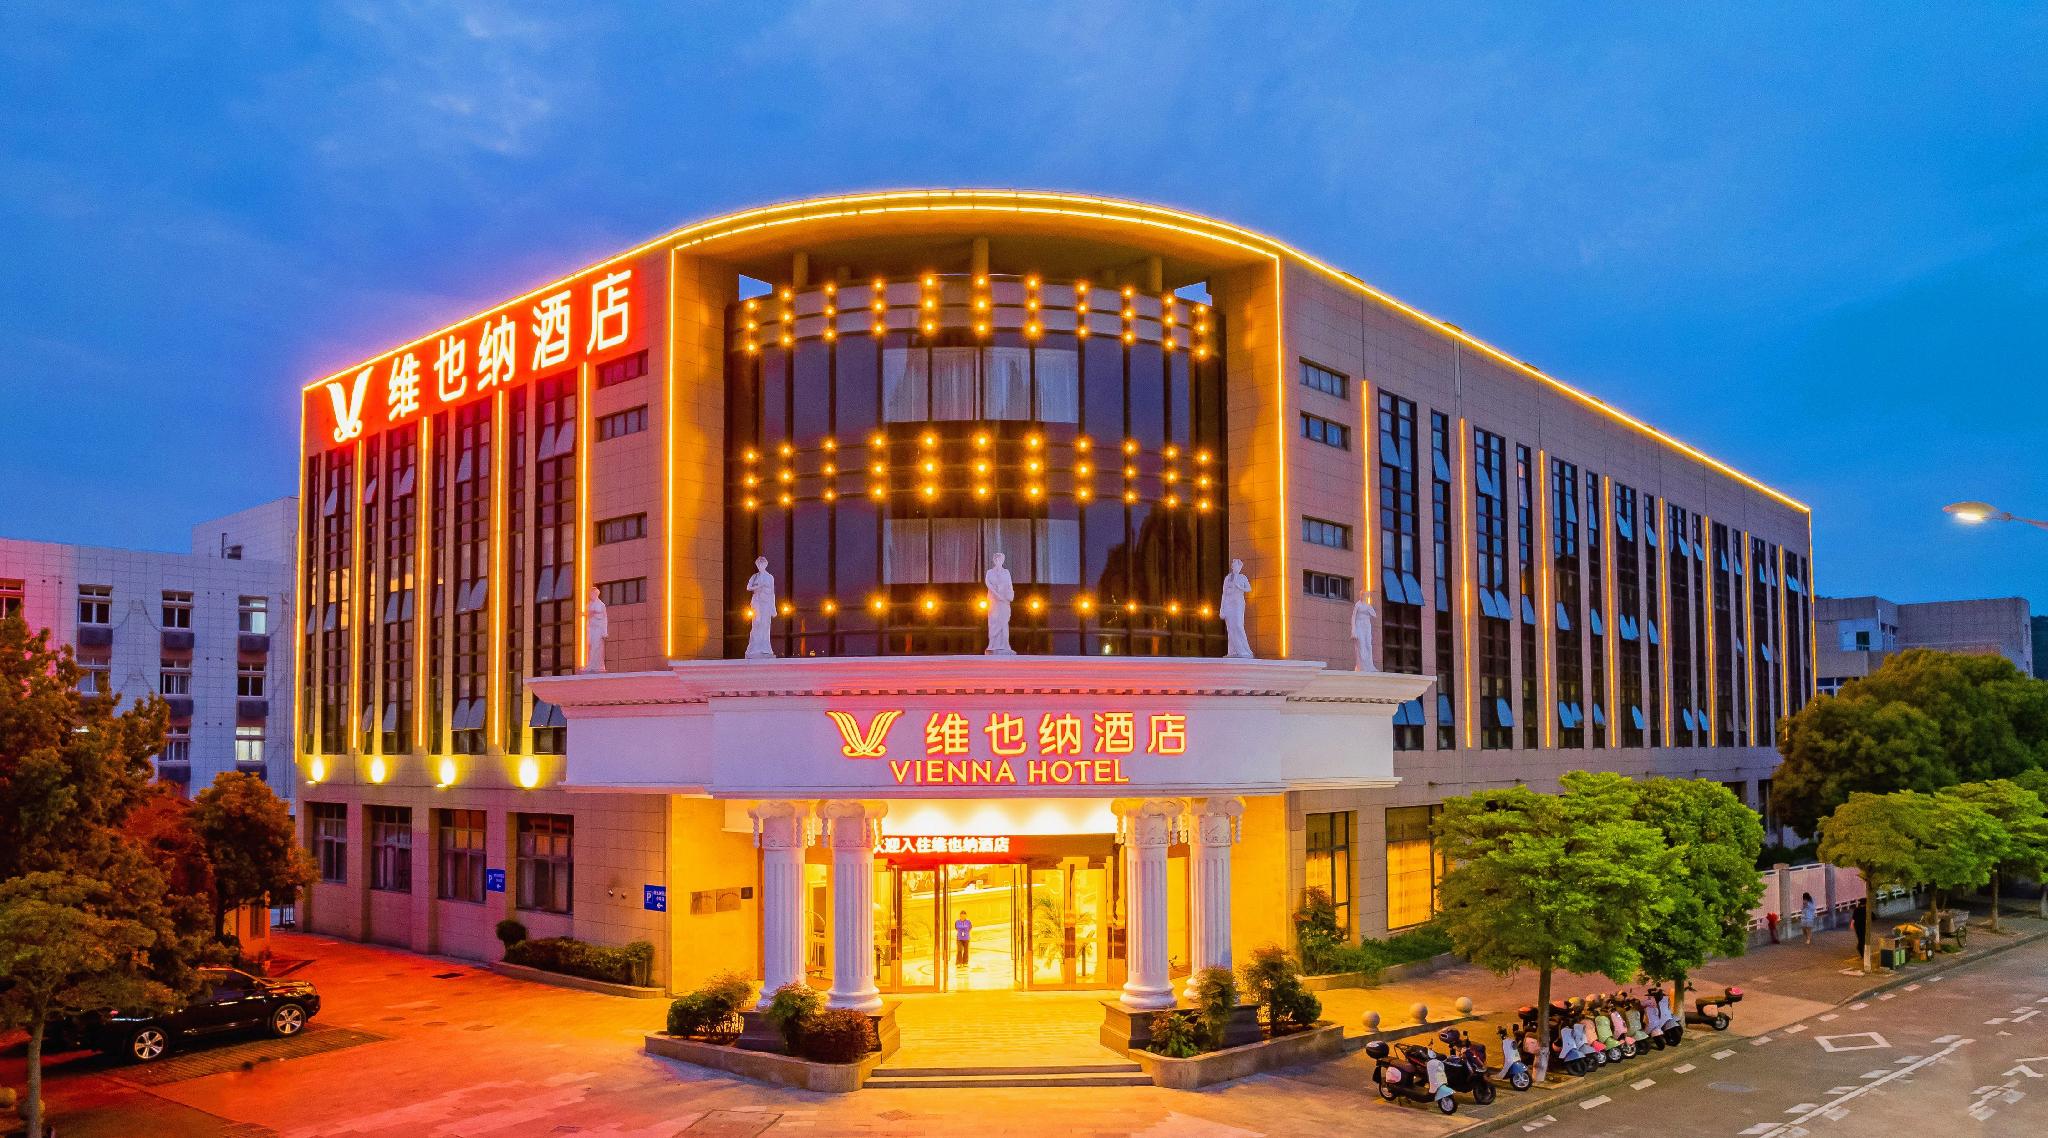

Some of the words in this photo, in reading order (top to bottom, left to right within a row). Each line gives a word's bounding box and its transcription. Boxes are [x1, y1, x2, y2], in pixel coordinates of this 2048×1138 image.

[387, 269, 632, 422] 维也纳酒店
[925, 711, 1186, 755] 维也纳酒店
[889, 759, 1016, 783] VIENNA
[1028, 759, 1129, 783] HOTEL
